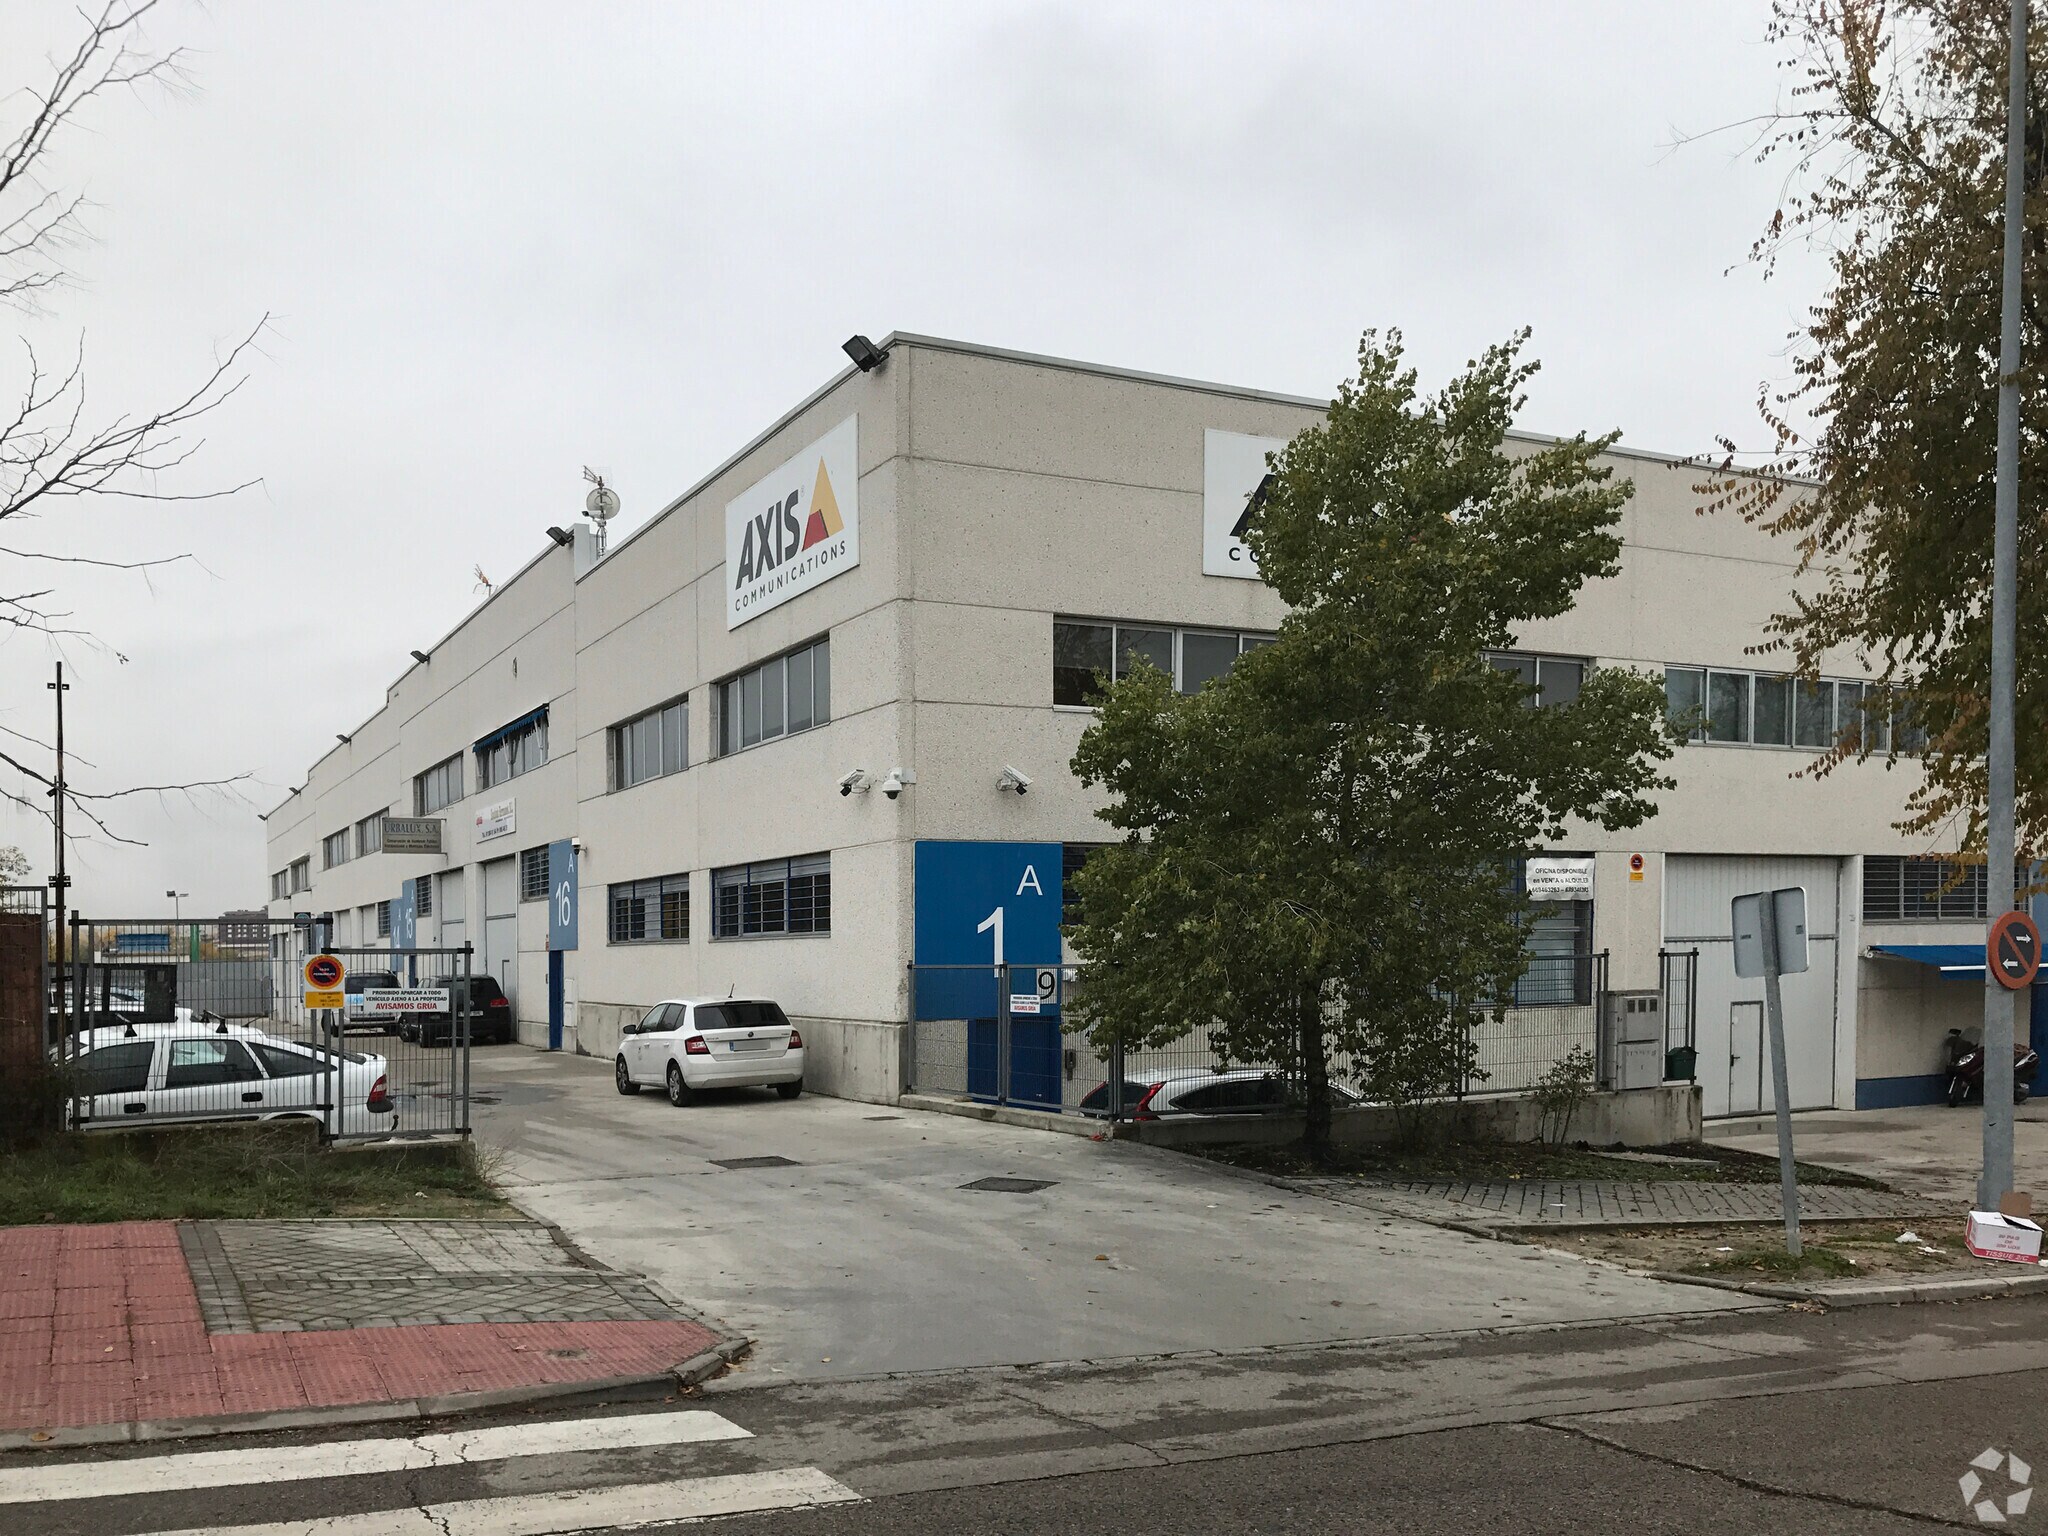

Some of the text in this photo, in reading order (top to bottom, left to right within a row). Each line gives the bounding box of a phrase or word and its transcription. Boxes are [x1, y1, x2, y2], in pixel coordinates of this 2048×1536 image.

[735, 489, 800, 590] AXIS
[735, 540, 846, 612] COMMUNICATIONS
[567, 852, 575, 873] A
[1015, 864, 1044, 896] A
[555, 880, 571, 927] 16
[404, 907, 413, 939] 15
[977, 906, 1005, 978] 1
[1037, 971, 1056, 1000] 9
[375, 1002, 415, 1010] AVISAMOS
[1985, 1250, 2014, 1260] TISSUE
